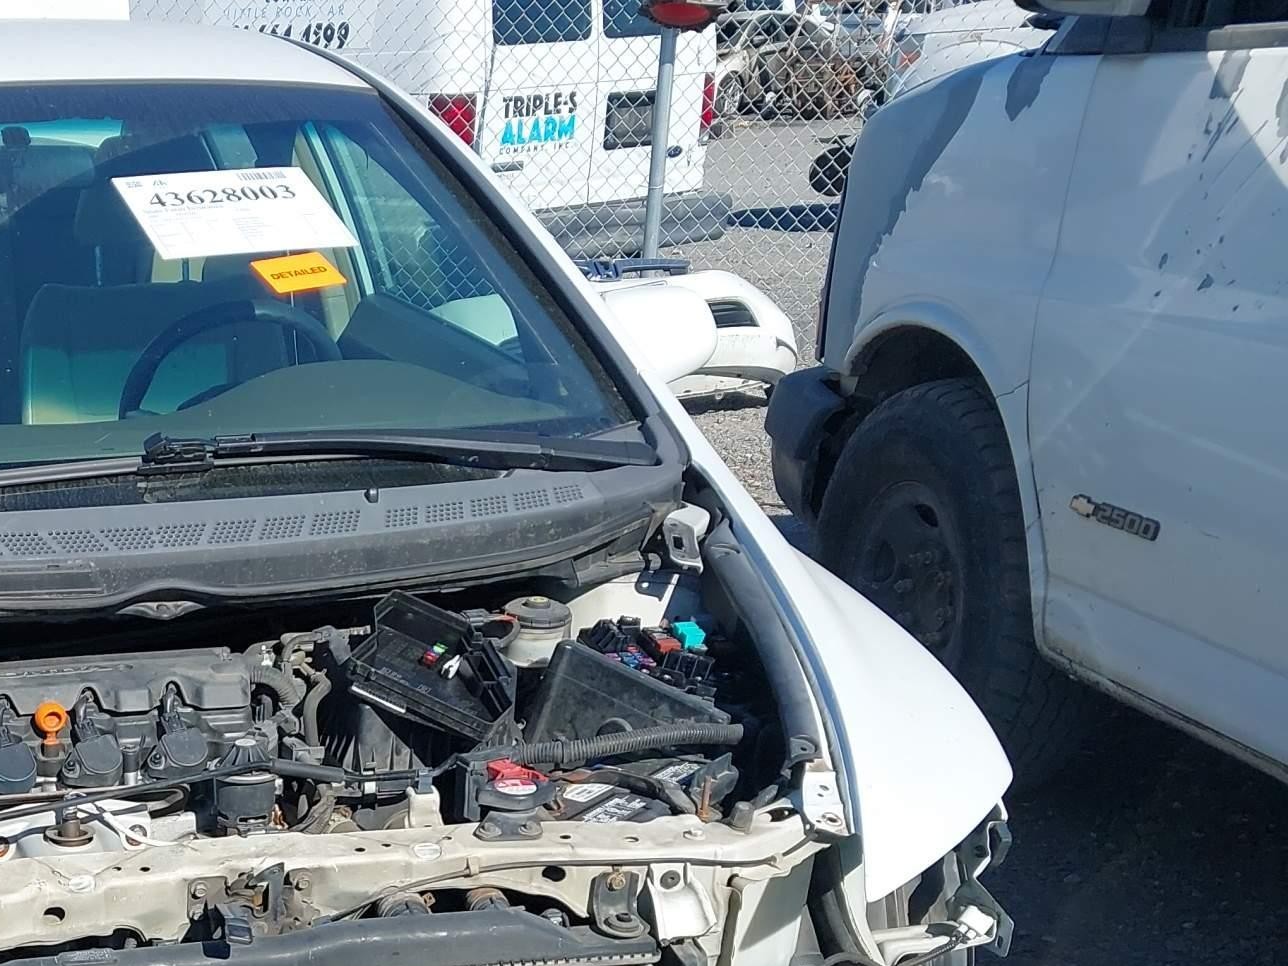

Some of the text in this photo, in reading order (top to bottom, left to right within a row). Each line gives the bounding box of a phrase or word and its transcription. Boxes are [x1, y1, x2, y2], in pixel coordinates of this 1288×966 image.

[275, 6, 312, 18] ROCK
[328, 5, 344, 16] AR
[502, 91, 577, 118] TRIPLE-S
[501, 114, 576, 145] ALARM
[149, 184, 296, 208] 43628003
[270, 265, 328, 280] DETAILED
[1096, 503, 1159, 541] 2500
